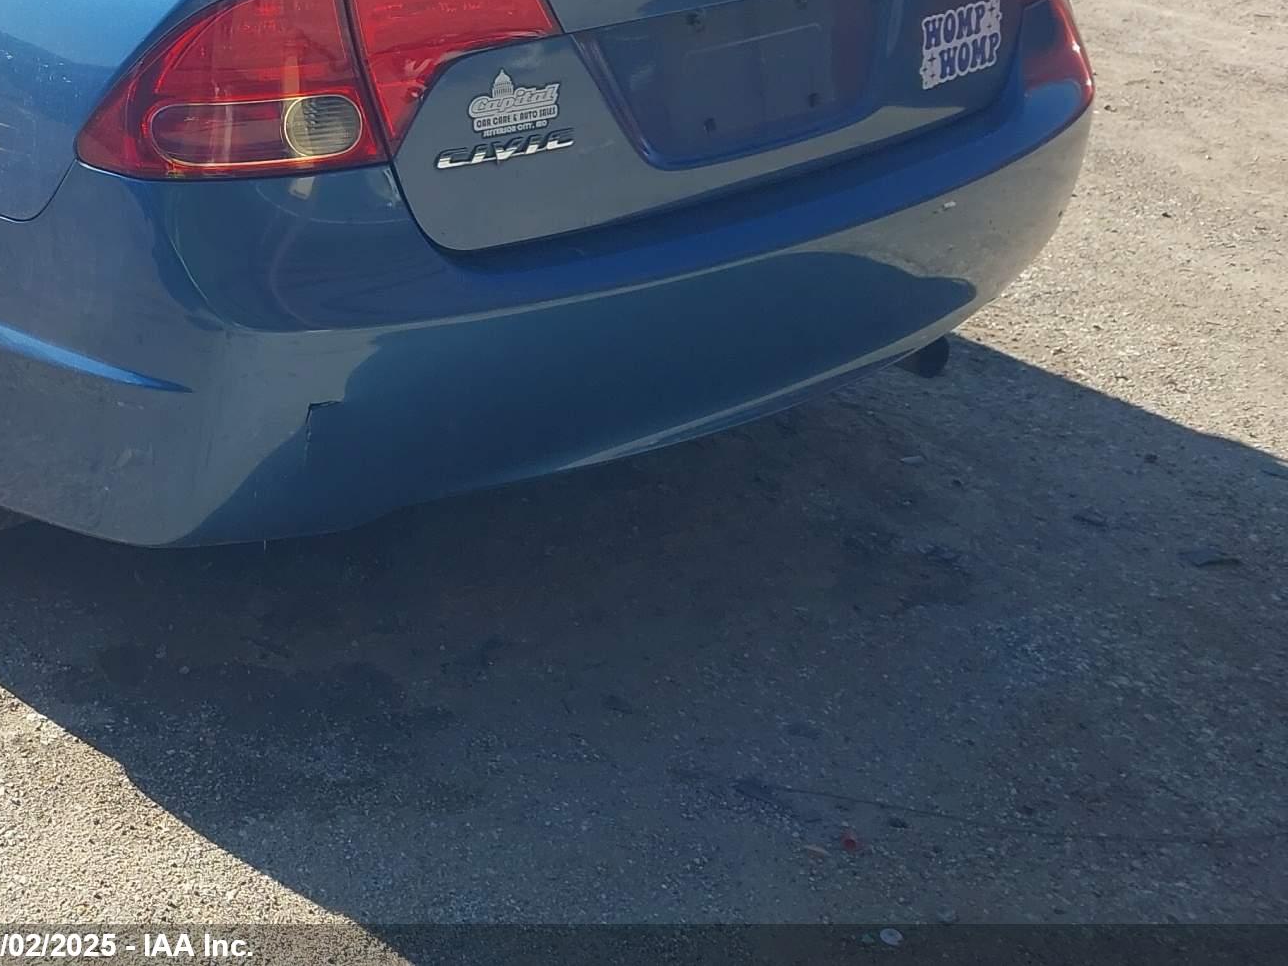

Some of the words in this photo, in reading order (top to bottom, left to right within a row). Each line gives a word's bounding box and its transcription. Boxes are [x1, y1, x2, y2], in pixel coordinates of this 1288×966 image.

[471, 86, 557, 113] Capital
[476, 117, 492, 128] CAR
[492, 114, 511, 126] CARE
[519, 109, 538, 121] AUTO
[539, 106, 556, 118] SALES
[436, 128, 575, 170] CIVIC
